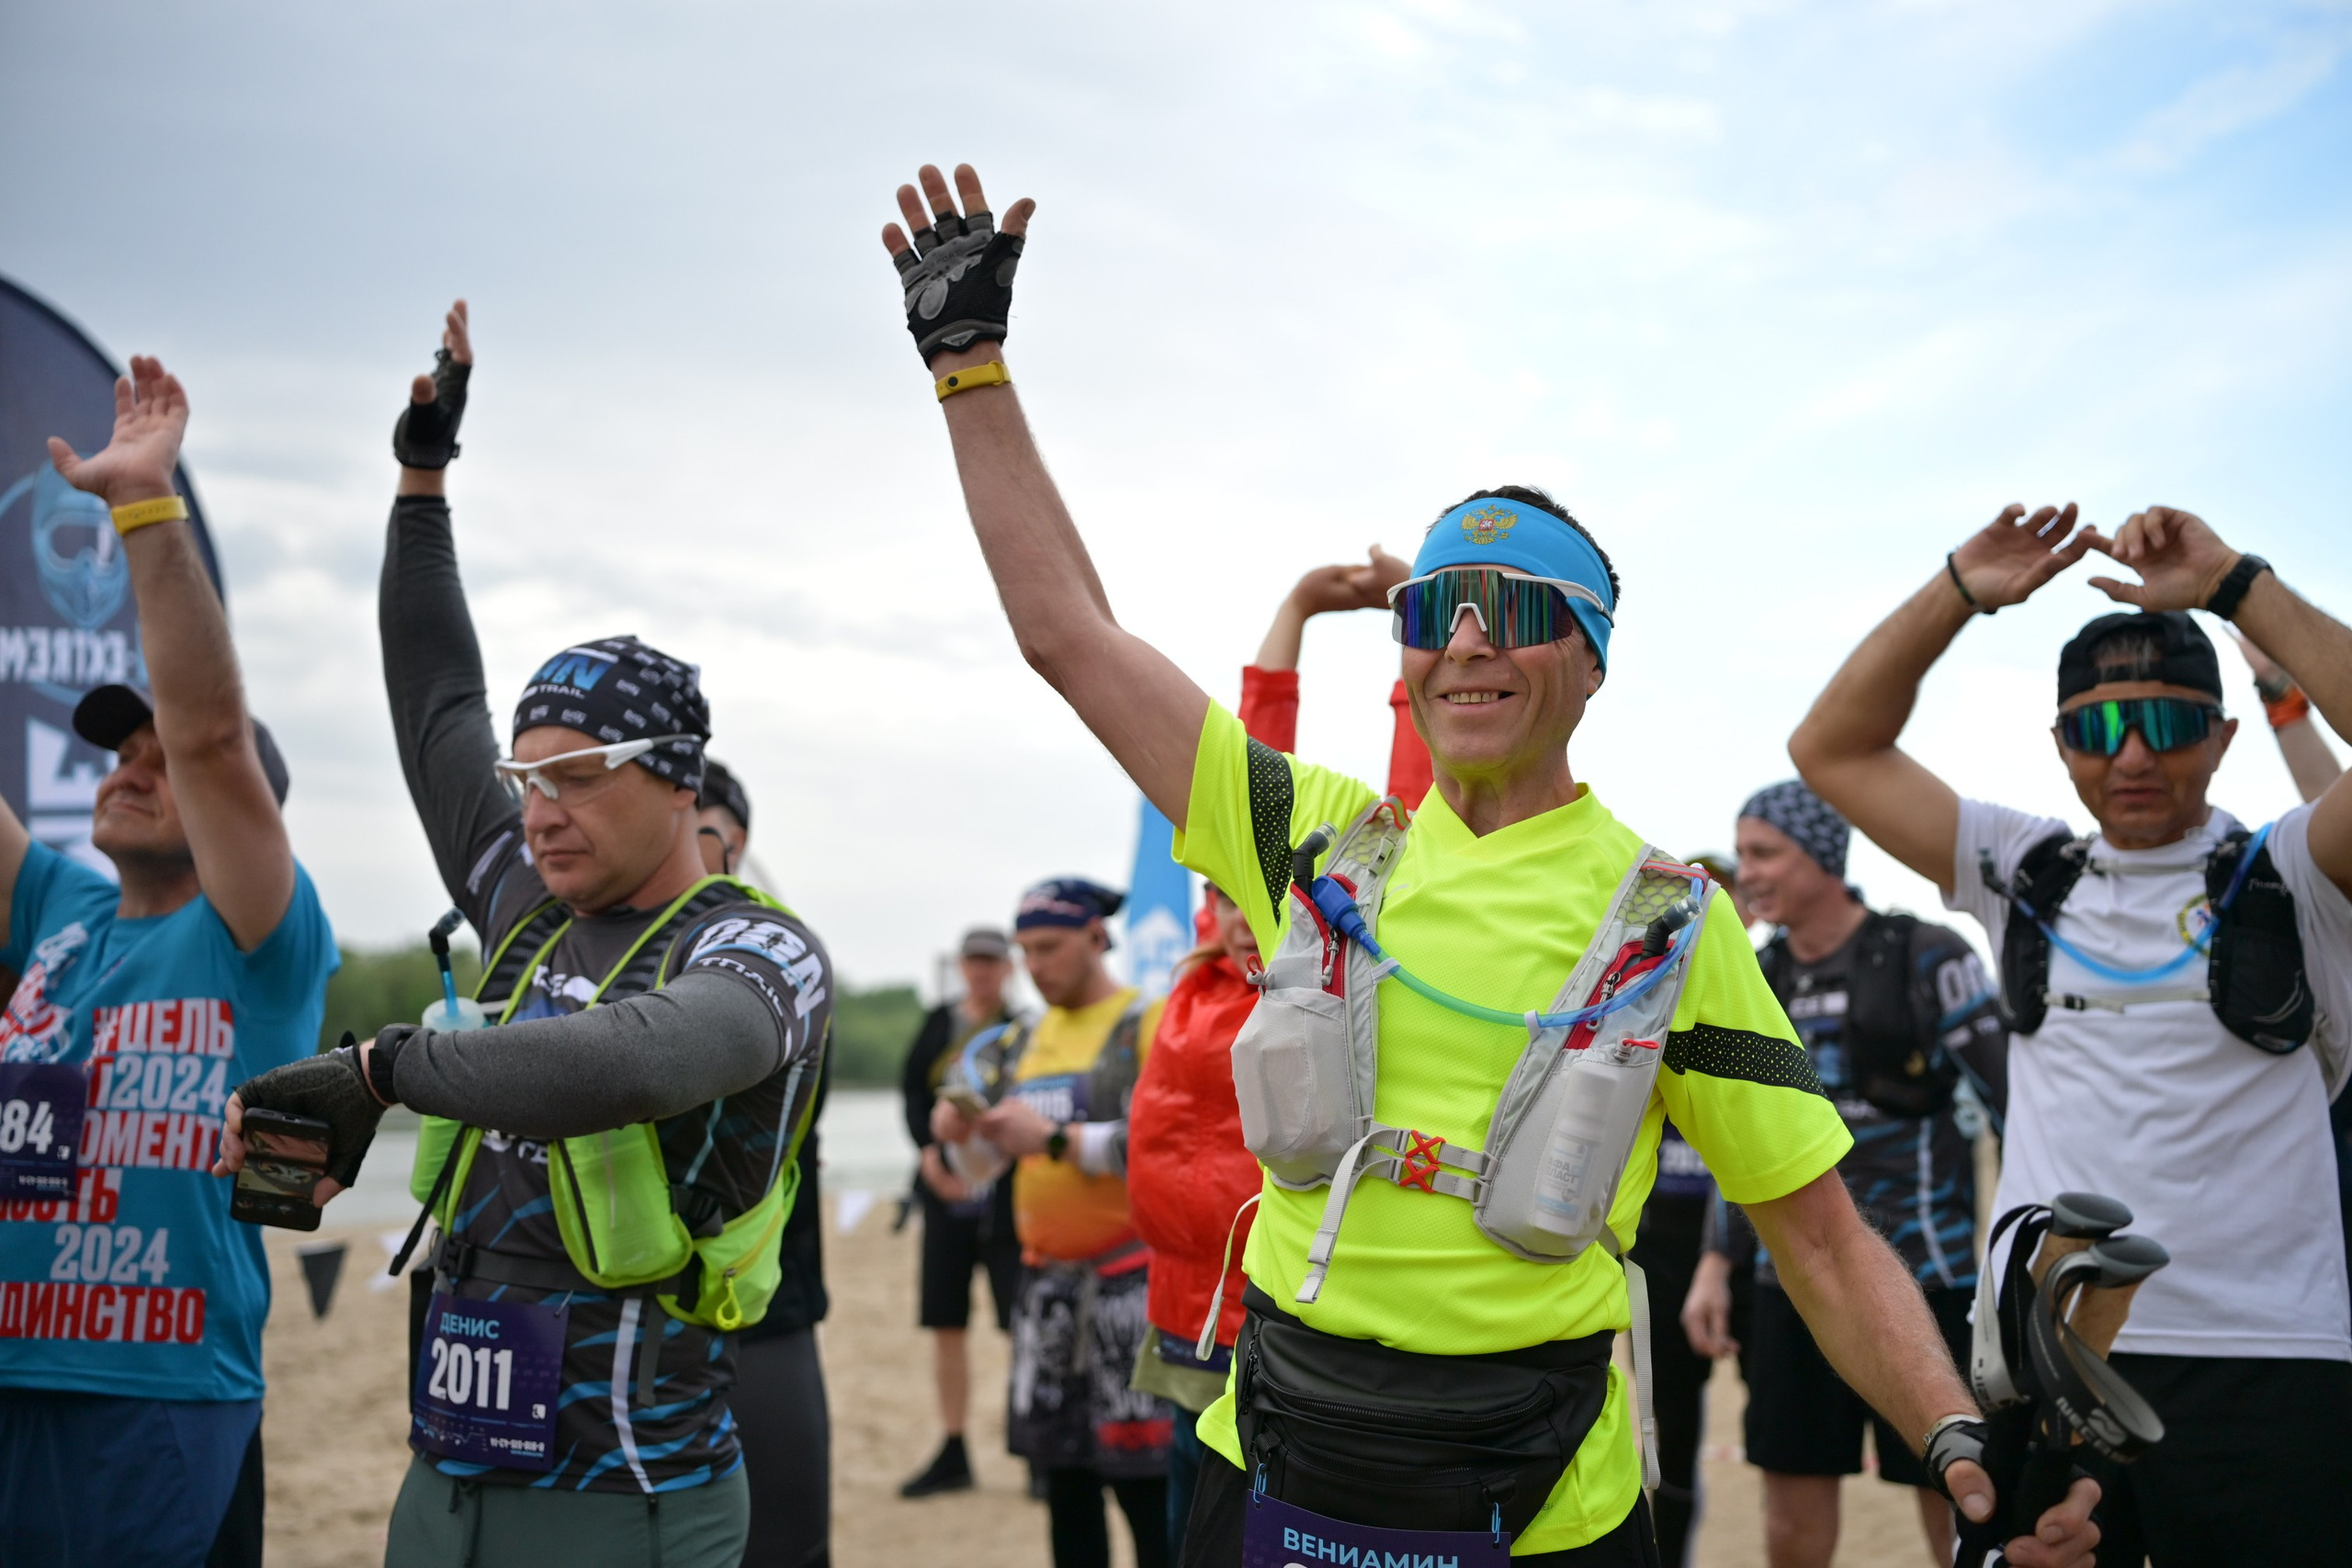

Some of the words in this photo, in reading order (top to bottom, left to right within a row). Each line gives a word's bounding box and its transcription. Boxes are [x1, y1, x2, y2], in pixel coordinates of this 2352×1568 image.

[538, 683, 585, 700] TRAIL
[109, 1054, 228, 1115] 2024
[0, 1099, 54, 1154] 84
[76, 1109, 221, 1172] ОМЕНТ
[50, 1224, 170, 1284] 2024
[0, 1282, 205, 1344] ДИНСТВО
[439, 1312, 500, 1339] ДЕНИС
[428, 1337, 513, 1411] 2011
[1283, 1527, 1459, 1568] ВЕНИАМИН
